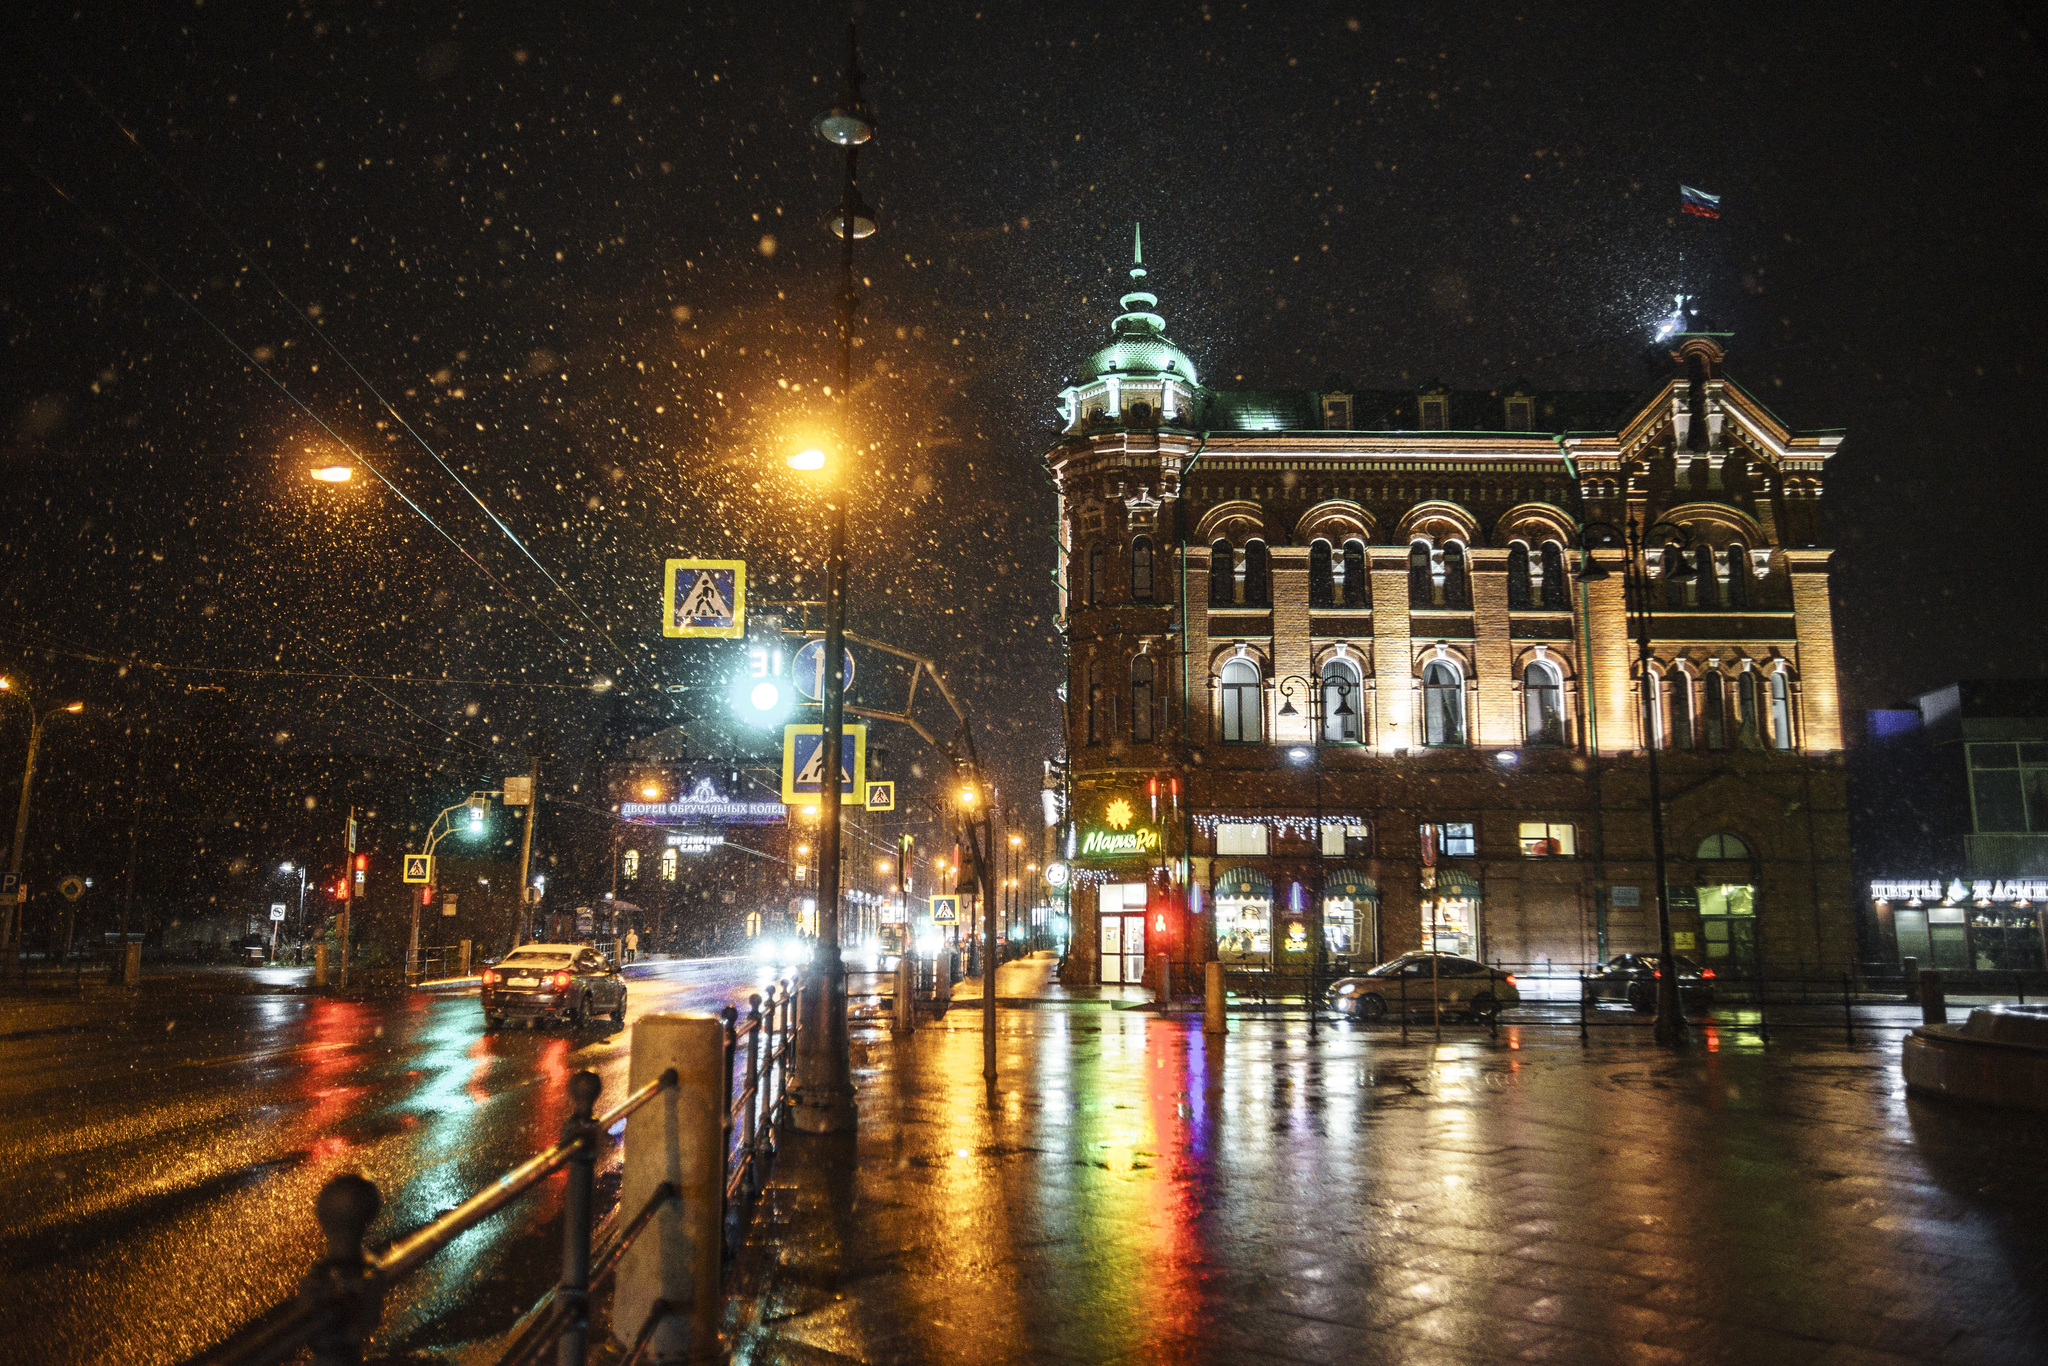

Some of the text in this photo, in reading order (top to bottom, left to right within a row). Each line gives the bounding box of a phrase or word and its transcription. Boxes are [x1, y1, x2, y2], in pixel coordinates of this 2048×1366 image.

[751, 650, 781, 678] 31
[622, 803, 667, 815] ДВОРЕЦ
[749, 803, 786, 815] КОЛЕЦ
[1870, 881, 2048, 900] ЦВЕТЫ ЖАСМИ
